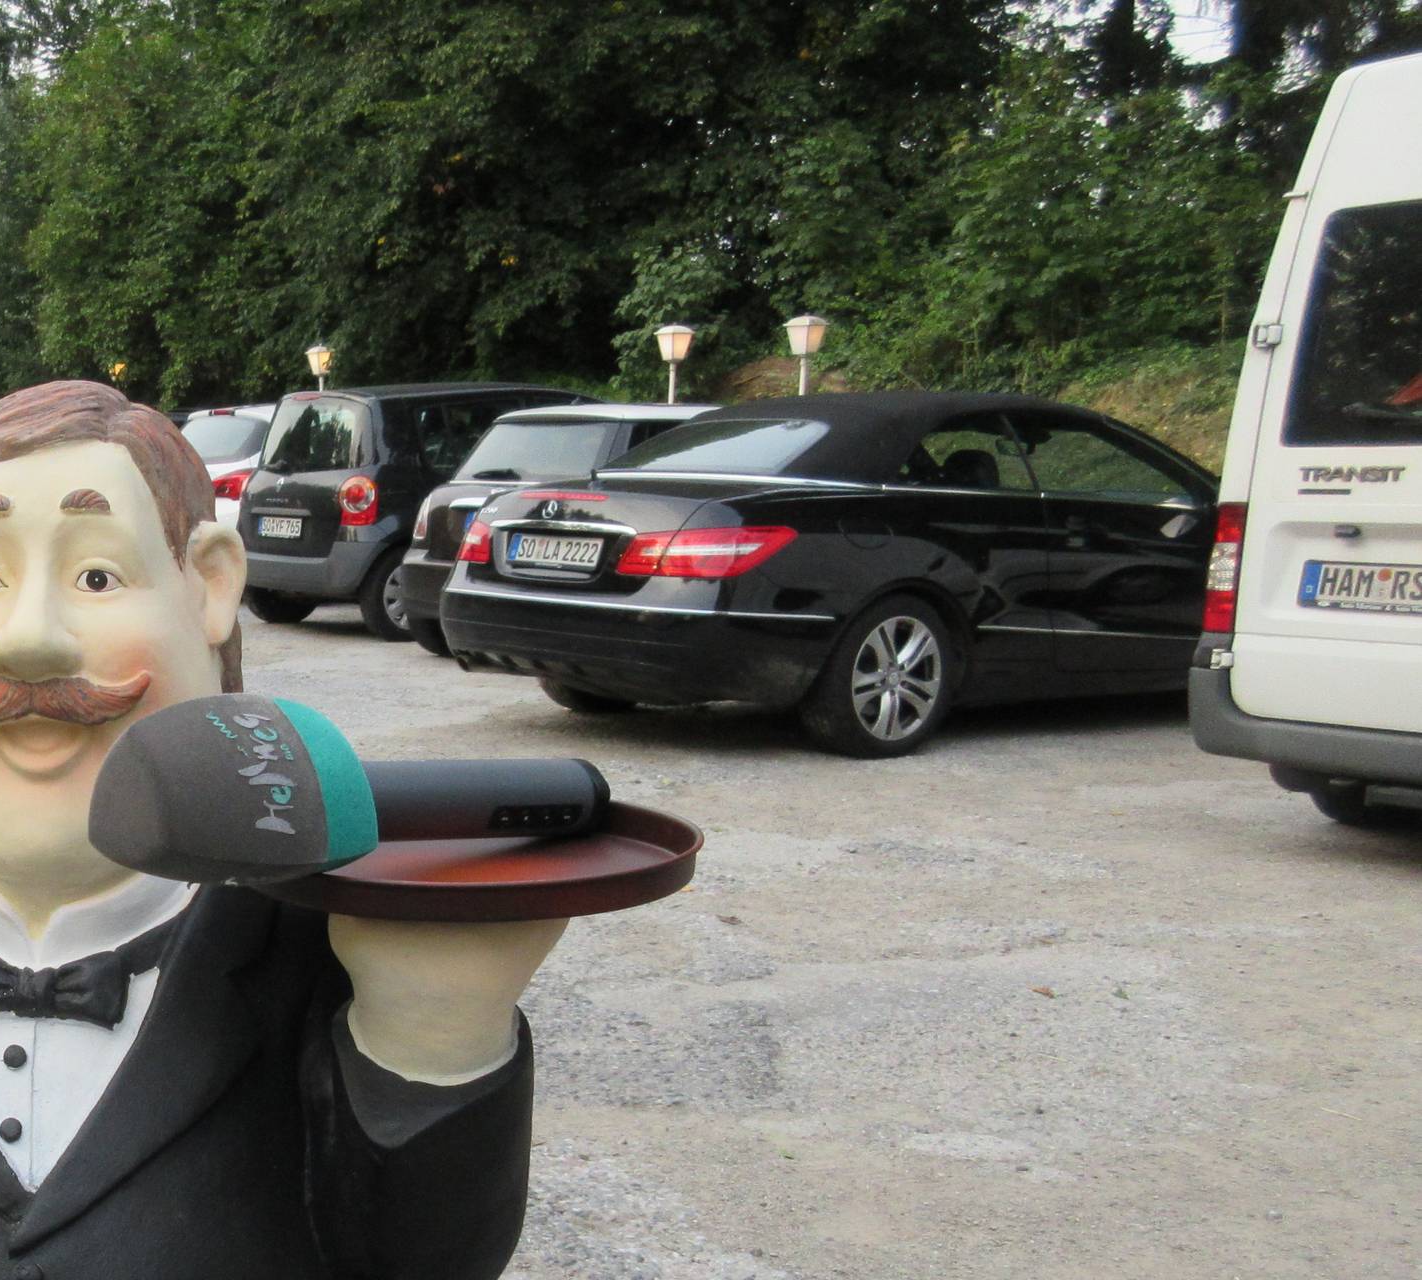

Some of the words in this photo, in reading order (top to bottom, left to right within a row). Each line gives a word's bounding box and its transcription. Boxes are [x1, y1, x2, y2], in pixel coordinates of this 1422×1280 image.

[1298, 466, 1406, 483] TRANSIT
[285, 519, 300, 534] 765
[519, 538, 536, 558] SO
[543, 540, 561, 560] LA
[562, 541, 599, 564] 2222
[1319, 566, 1375, 599] HAM
